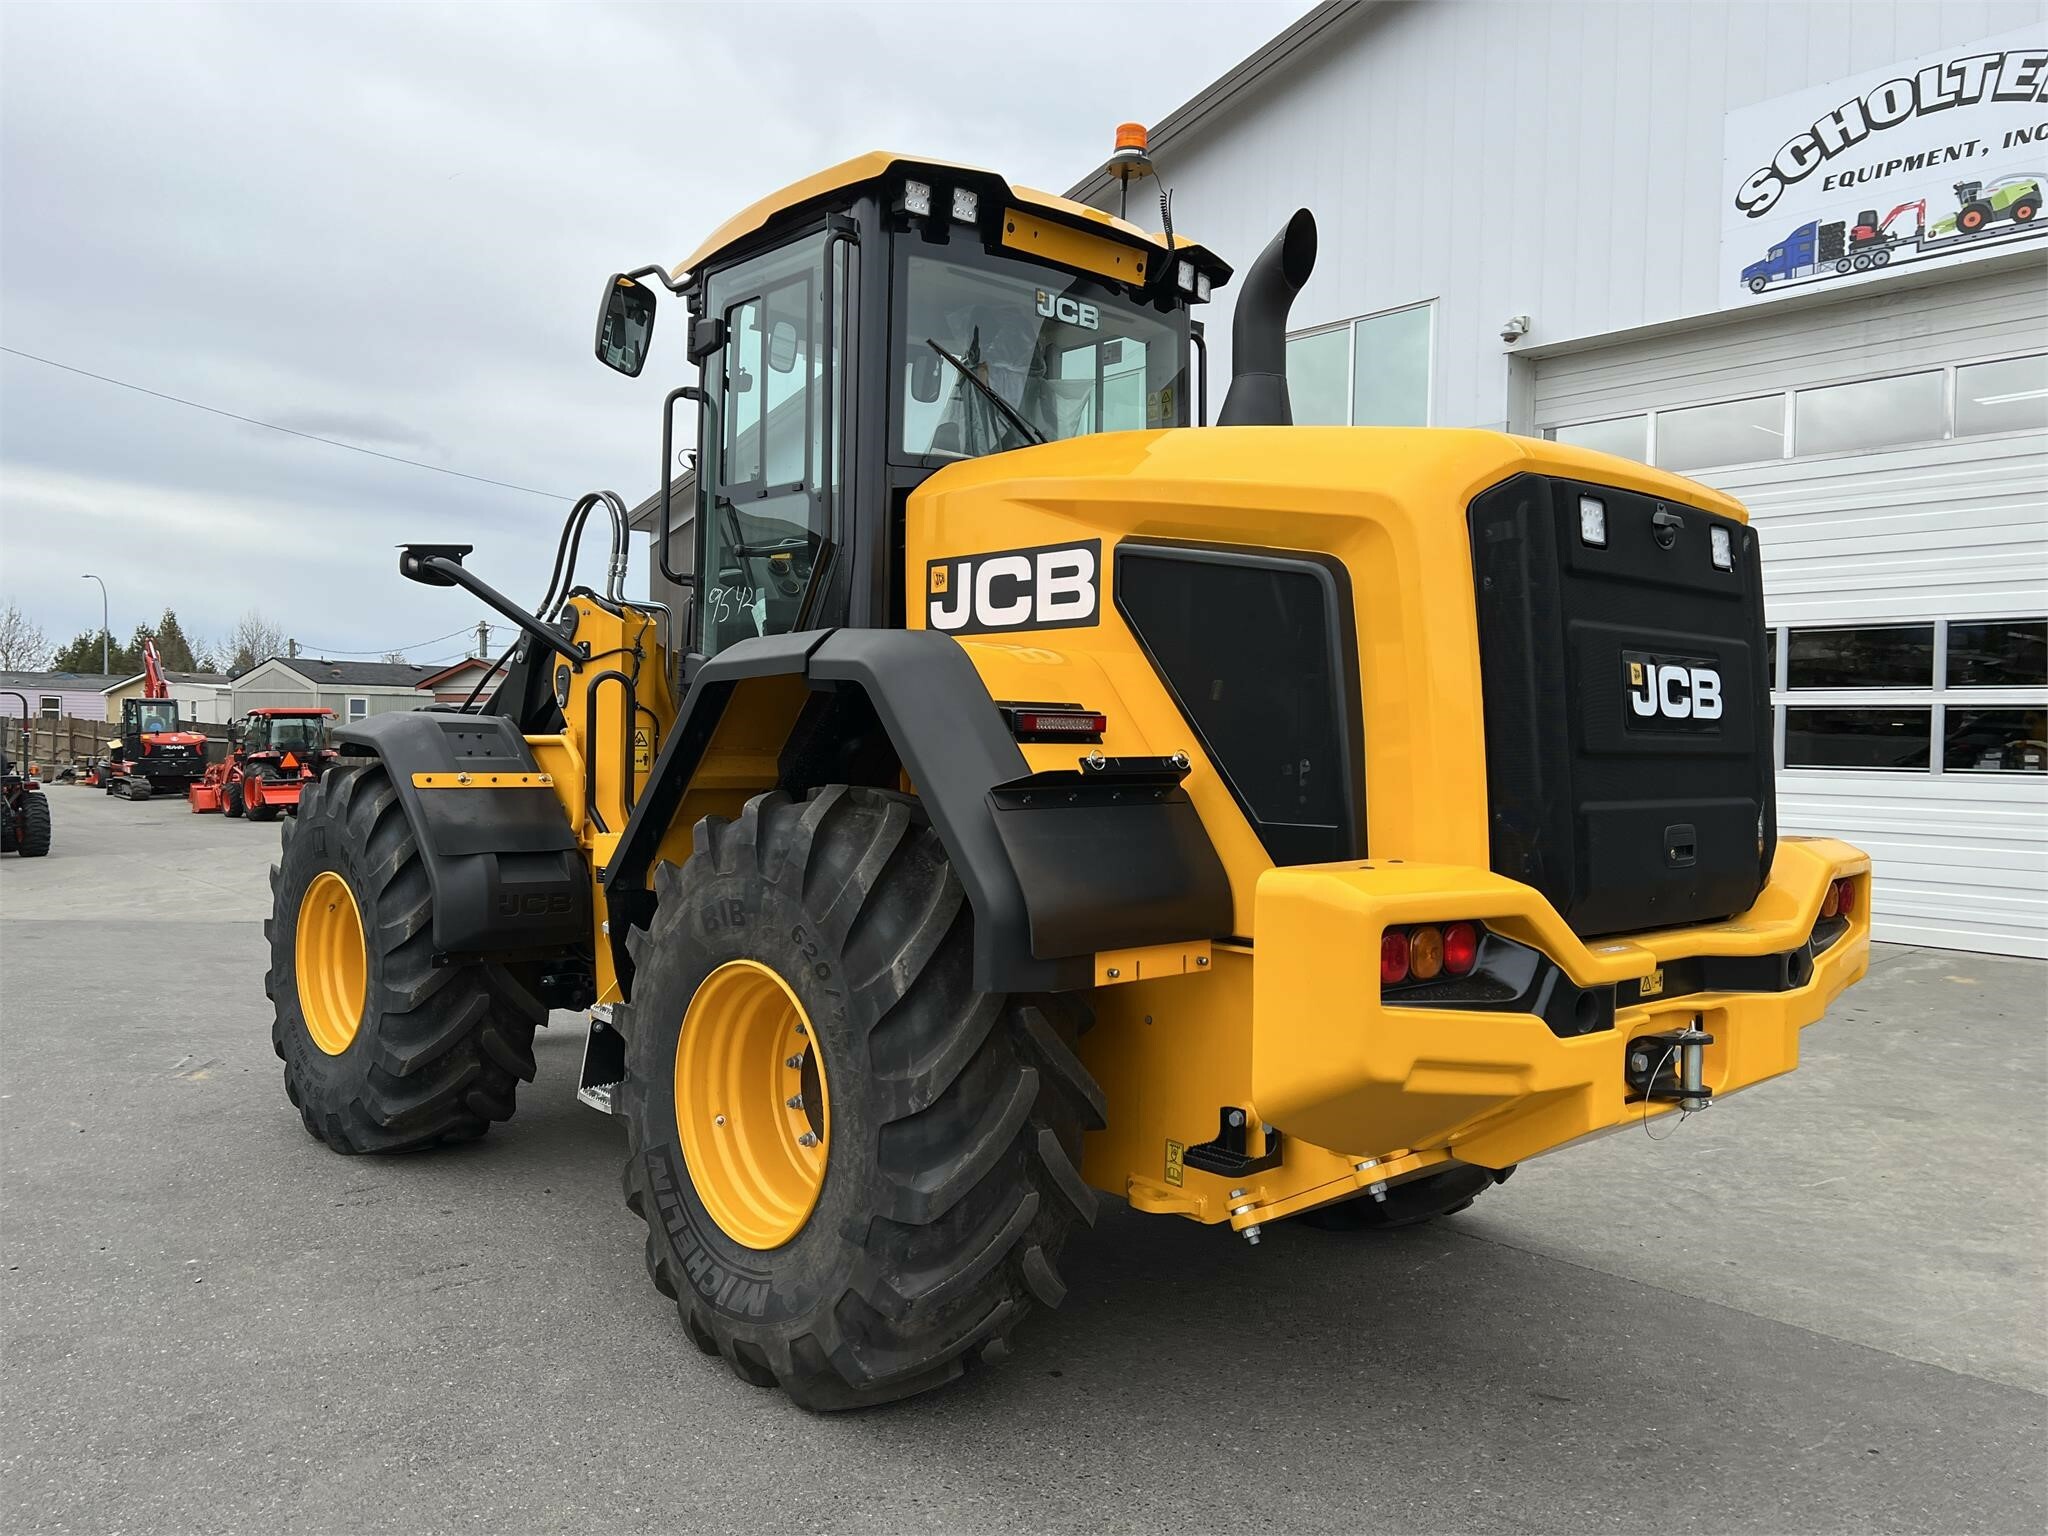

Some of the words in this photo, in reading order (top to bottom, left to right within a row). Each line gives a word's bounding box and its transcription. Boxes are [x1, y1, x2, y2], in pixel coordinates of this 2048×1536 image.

[1735, 49, 2048, 218] SCHOLTE
[1822, 139, 1989, 192] EQUIPMENT,
[1037, 294, 1099, 330] JCB
[709, 585, 754, 624] 9542
[930, 548, 1096, 630] JCB
[1631, 664, 1723, 719] JCB
[498, 894, 575, 917] JCB
[647, 1152, 770, 1317] MICHELIN
